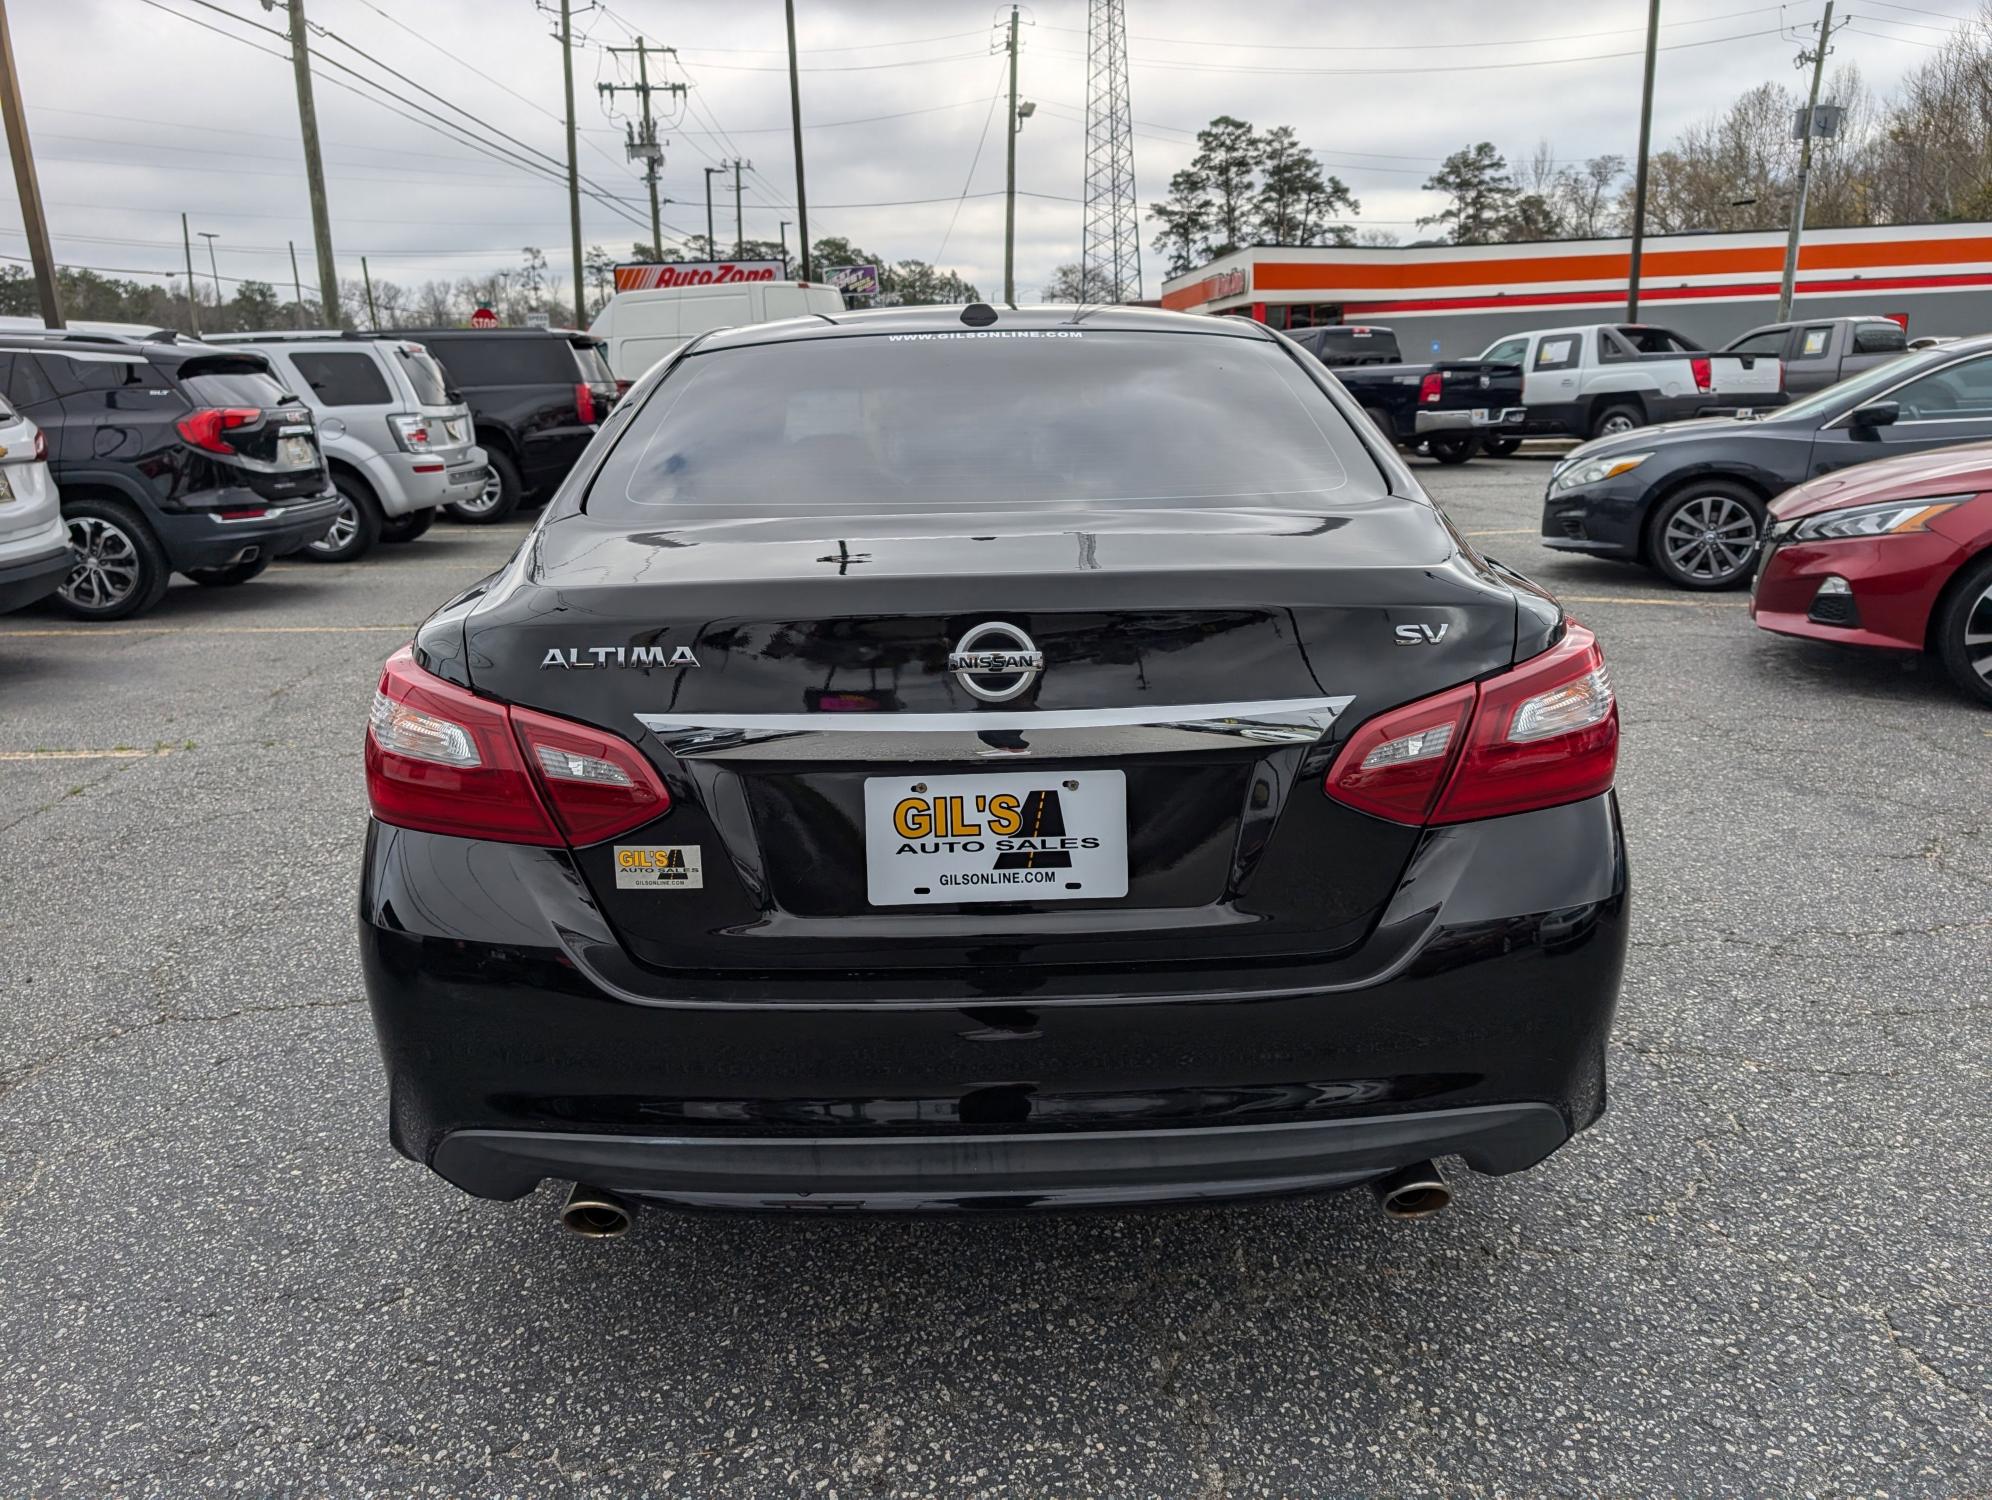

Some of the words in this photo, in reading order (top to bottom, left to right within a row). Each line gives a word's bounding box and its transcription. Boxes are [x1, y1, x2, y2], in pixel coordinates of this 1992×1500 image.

[655, 264, 773, 288] AutoZone
[472, 317, 498, 328] STOP
[889, 331, 1083, 341] WWW.GILSONLINE.COM
[1394, 623, 1449, 646] SV
[539, 646, 701, 671] ALTIMA
[958, 655, 1034, 670] NISSAN
[893, 794, 1022, 839] GIL'S
[895, 840, 986, 855] AUTO
[995, 836, 1101, 852] SALES
[618, 850, 669, 867] GIL'S
[938, 870, 1057, 886] GILSONLINE.COM
